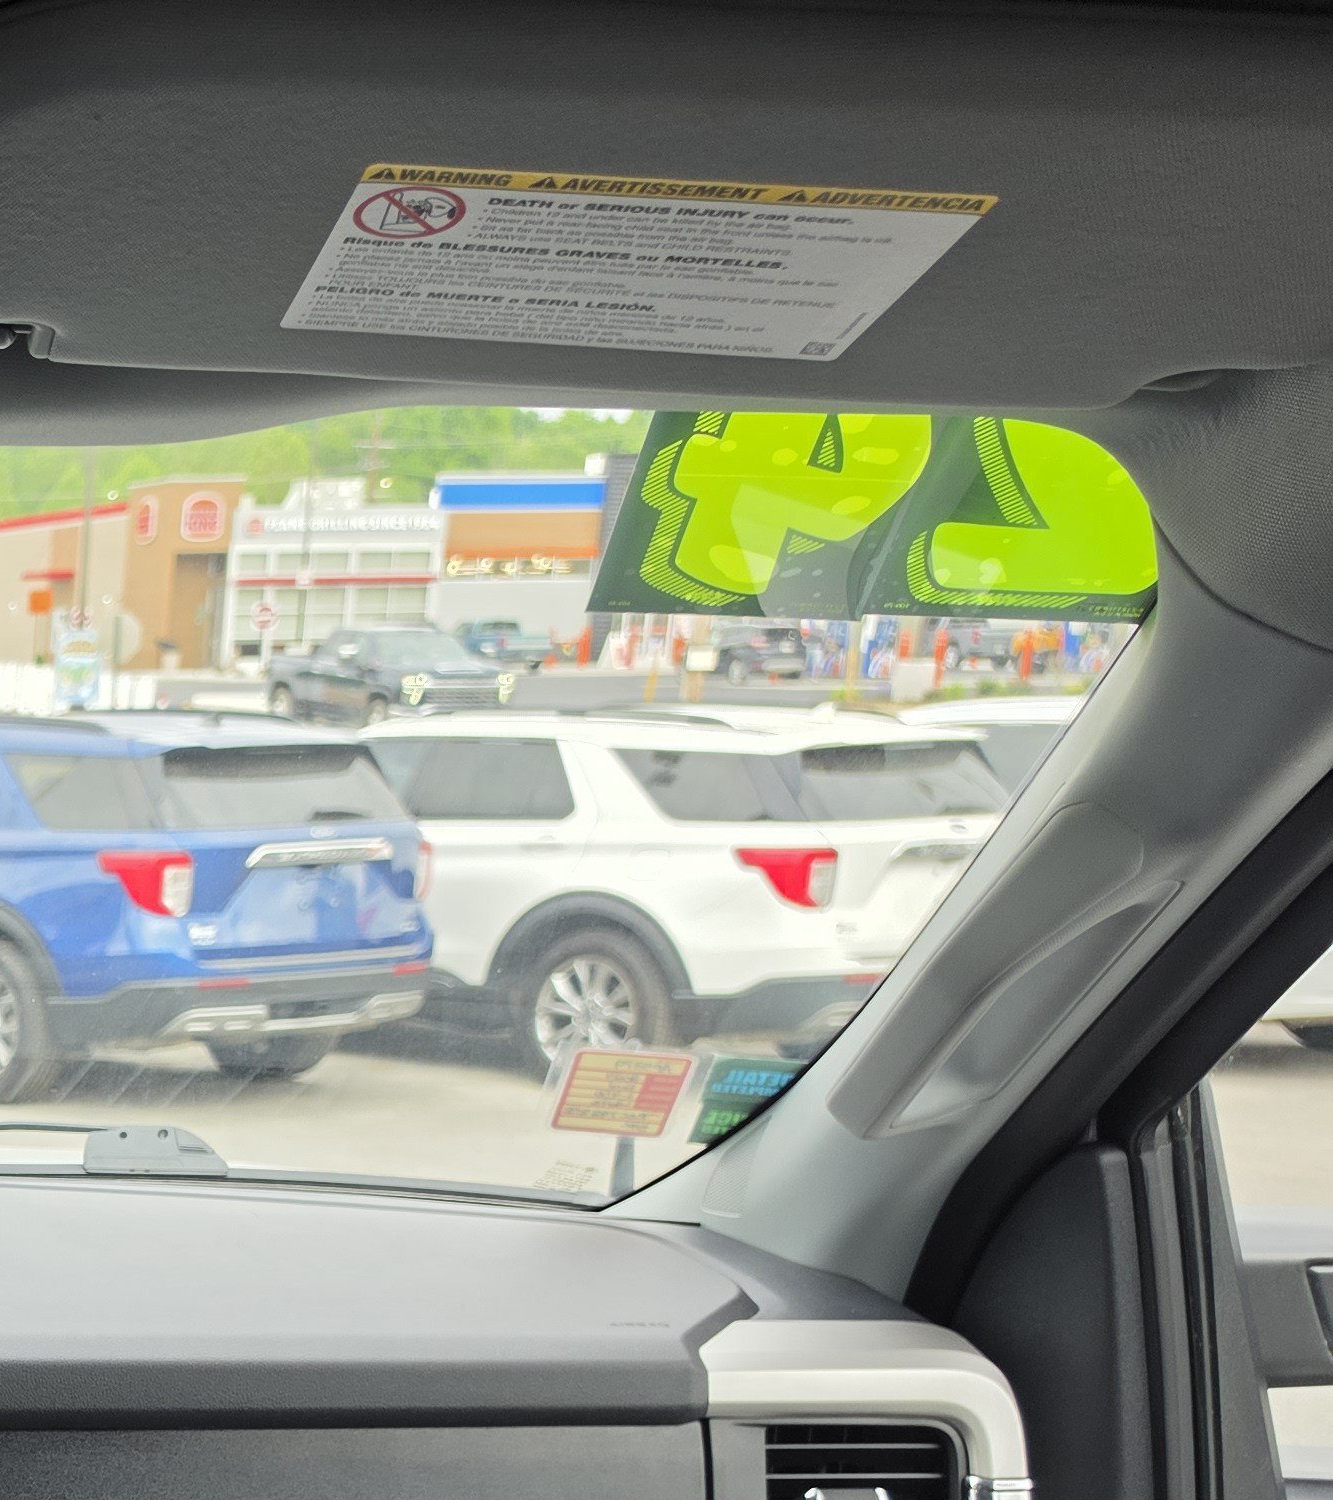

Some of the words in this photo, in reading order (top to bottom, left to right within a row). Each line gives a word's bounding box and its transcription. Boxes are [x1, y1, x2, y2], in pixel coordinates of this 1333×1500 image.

[400, 169, 514, 187] WARNING
[562, 178, 768, 200] AVERTISSEMENT
[810, 191, 986, 210] ADVERTENCIA
[487, 198, 554, 208] DEATH
[584, 203, 672, 215] SERIOUS
[676, 207, 751, 218] INJURY
[794, 216, 854, 224] occur.
[343, 237, 405, 248] Risque
[438, 242, 550, 256] BLESSURES
[555, 249, 631, 260] GRAVES
[665, 255, 789, 270] MORTELLES.
[314, 285, 394, 296] PELIGRO
[426, 292, 505, 303] MUERTE
[525, 298, 579, 308] SERIA
[584, 300, 656, 312] LESIÓN.
